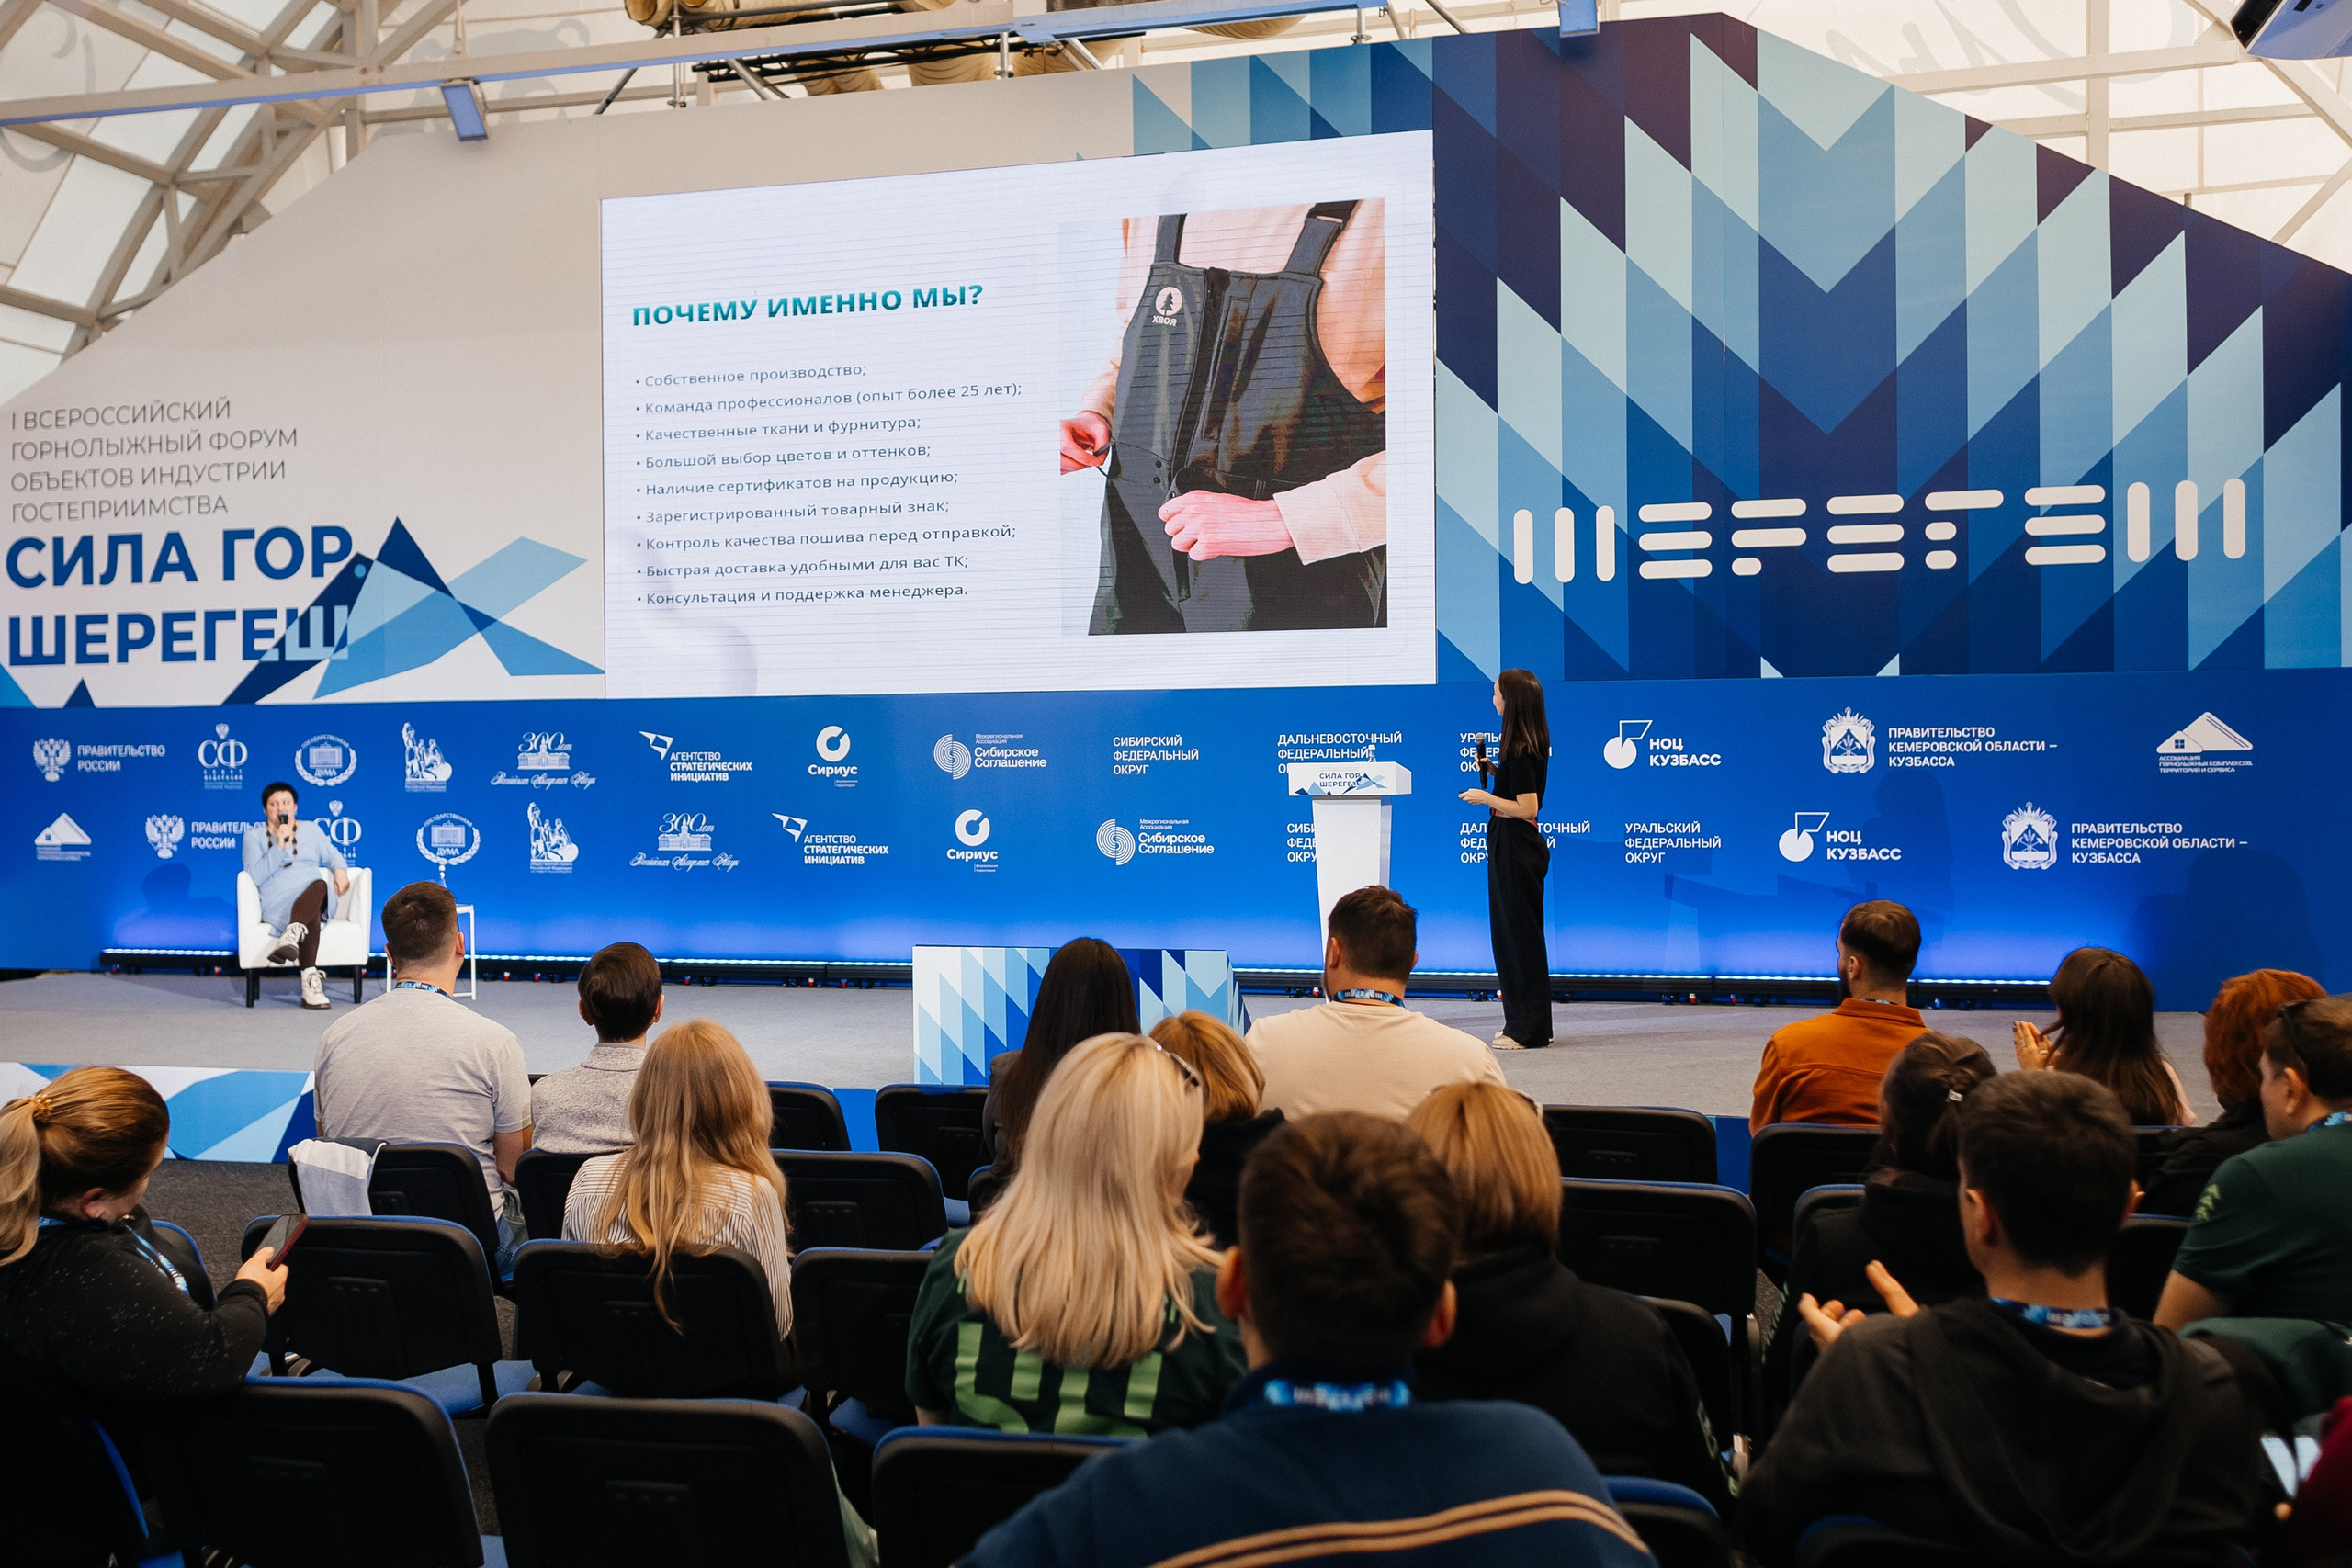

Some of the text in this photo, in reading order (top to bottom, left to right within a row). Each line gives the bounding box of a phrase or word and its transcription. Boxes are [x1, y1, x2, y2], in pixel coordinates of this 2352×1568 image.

[633, 285, 982, 325] ПОЧЕМУ ИМЕННО МЫ?
[1152, 315, 1177, 327] ХВОЯ
[645, 366, 865, 386] Собственное производство;
[645, 382, 1021, 413] Команда профессионалов (опыт более 25 лет);
[23, 395, 230, 431] ВСЕРОССИЙСКИЙ
[645, 418, 920, 440] Качественные ткани и фурнитура;
[11, 427, 296, 461] ГОРНОЛЫЖНЫЙ ФОРУМ
[646, 446, 930, 468] Большой выбор цветов и оттенков;
[10, 459, 285, 492] ОБЪЕКТОВ ИНДУСТРИИ
[646, 473, 957, 494] Наличие сертификатов на продукцию;
[12, 494, 228, 523] ГОСТЕПРИИМСТВА
[646, 501, 948, 525] Зарегистрированный товарный знак;
[646, 524, 1015, 551] Контроль качества пошива перед отправкой;
[6, 525, 355, 588] СИЛА ГОР
[646, 555, 967, 579] Быстрая доставка удобными для вас ТК;
[647, 586, 967, 605] Консультация и поддержка менеджера.
[7, 604, 349, 667] ШЕРЕГЕШ
[1277, 730, 1401, 746] ДАЛЬНЕВОСТОЧНЫЙ
[1888, 727, 1995, 738] ПРАВИТЕЛЬСТВО
[1113, 734, 1182, 746] СИБИРСКИЙ
[1649, 737, 1683, 751] НОЦ
[1888, 739, 1982, 752] КЕМЕРОВСКОЙ
[1984, 740, 2045, 751] ОБЛАСТИ
[77, 744, 165, 756] ПРАВИТЕЛЬСТВО
[198, 739, 248, 769] СФ
[669, 751, 720, 761] АГЕНТСТВО
[974, 746, 1038, 759] Сибирское
[1113, 748, 1198, 762] ФЕДЕРАЛЬНЫЙ
[1277, 745, 1369, 761] ФЕДЕРАЛЬНЫЙ
[77, 760, 120, 771] РОССИИ
[669, 761, 752, 771] СТРАТЕГИЧЕСКИХ
[974, 757, 1046, 767] Соглашение
[1649, 753, 1721, 766] КУЗБАСС
[1888, 756, 1954, 766] КУЗБАССА
[808, 763, 857, 777] Сириус
[1113, 764, 1148, 774] ОКРУГ
[670, 772, 729, 782] ИНИЦИАТИВ
[191, 821, 266, 835] ПРАВИТЕЛЬ
[1624, 820, 1700, 833] УРАЛЬСКИЙ
[2071, 822, 2182, 833] ПРАВИТЕЛЬСТВО
[191, 836, 235, 849] РОССИИ
[803, 834, 856, 843] АГЕНТСТВО
[1137, 831, 1205, 845] Сибирское
[1624, 835, 1721, 850] ФЕДЕРАЛЬНЫЙ
[1826, 830, 1862, 844] НОЦ
[2071, 835, 2168, 848] КЕМЕРОВСКОЙ
[2172, 837, 2234, 848] ОБЛАСТИ
[435, 846, 460, 856] ДУМА
[803, 845, 888, 853] СТРАТЕГИЧЕСКИХ
[946, 848, 998, 862] Сириус
[1138, 843, 1214, 853] Соглашение
[1826, 847, 1901, 860] КУЗБАСС
[804, 855, 865, 865] ИНИЦИАТИВ
[1624, 852, 1665, 863] ОКРУГ
[2072, 852, 2141, 863] КУЗБАССА
